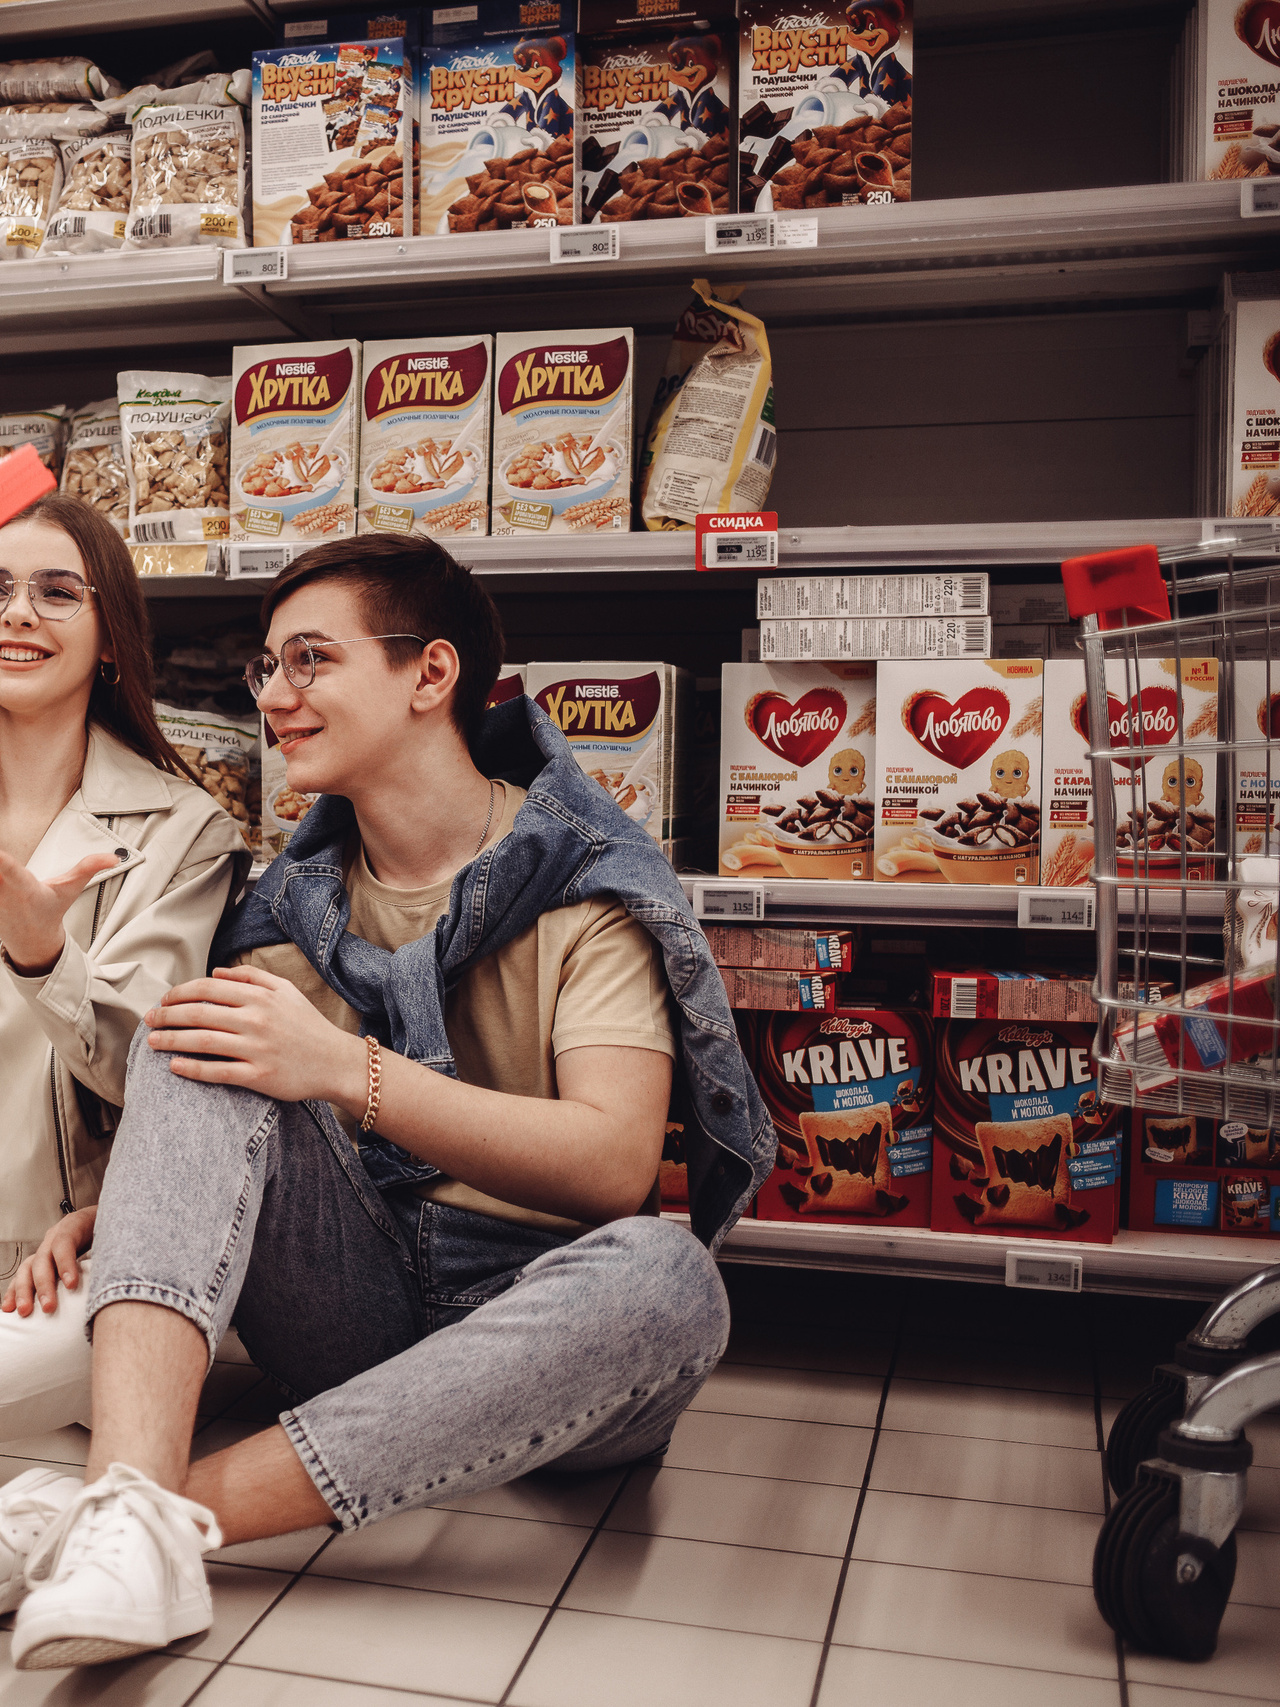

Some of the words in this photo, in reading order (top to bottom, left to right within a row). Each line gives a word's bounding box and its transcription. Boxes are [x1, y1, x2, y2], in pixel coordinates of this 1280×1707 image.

[753, 26, 849, 51] Вкусти
[752, 44, 847, 75] хрусти
[261, 62, 336, 85] Вкусти
[431, 65, 516, 90] Вкусти
[583, 64, 670, 89] Вкусти
[752, 74, 817, 87] Подушечки
[1218, 78, 1248, 87] ПОДУШЕЧКИ
[261, 78, 335, 103] хрусти
[765, 84, 809, 93] шоколадной
[1218, 88, 1225, 97] С
[431, 82, 515, 112] хрусти
[583, 82, 670, 112] хрусти
[1218, 92, 1276, 108] НАЧИНКОЙ
[261, 101, 316, 113] Подушечки
[431, 110, 487, 122] Подушечки
[583, 109, 642, 122] Подушечки
[205, 217, 226, 227] 200
[523, 409, 560, 420] МОЛОЧНЫЕ
[1246, 417, 1254, 426] С
[379, 506, 391, 515] БЕЗ
[516, 503, 527, 511] БЕЗ
[250, 510, 261, 519] БЕЗ
[206, 520, 227, 530] 200
[709, 516, 764, 530] СКИДКА
[496, 527, 510, 536] 250
[943, 579, 954, 596] 220
[946, 622, 957, 639] 220
[1007, 666, 1034, 674] НОВИНКА
[762, 707, 839, 751] Любятово
[920, 706, 1002, 753] Любятово
[161, 727, 241, 747] ОДУШЕЧКИ
[730, 772, 738, 781] С
[739, 770, 798, 782] БАНАНОВОЙ
[886, 774, 893, 784] С
[894, 773, 958, 784] БАНАНОВОЙ
[1054, 776, 1061, 786] С
[730, 782, 780, 791] НАЧИНКОЙ
[886, 784, 939, 794] НАЧИНКОЙ
[828, 934, 842, 969] KRAVE
[811, 975, 825, 1010] KRAVE
[820, 1016, 873, 1039] Kellogg's
[782, 1038, 910, 1085] KRAVE
[959, 1048, 1093, 1094] KRAVE
[835, 1085, 870, 1098] ШОКОЛАД
[833, 1099, 840, 1109] И
[841, 1094, 874, 1108] МОЛОКО
[1014, 1096, 1049, 1108] ШОКОЛАД
[1011, 1109, 1019, 1119] И
[1020, 1104, 1054, 1118] МОЛОКО
[1173, 1181, 1208, 1189] ПОПРОБУЙ
[1227, 1182, 1264, 1195] KRAVE
[1173, 1192, 1208, 1201] KRAVE
